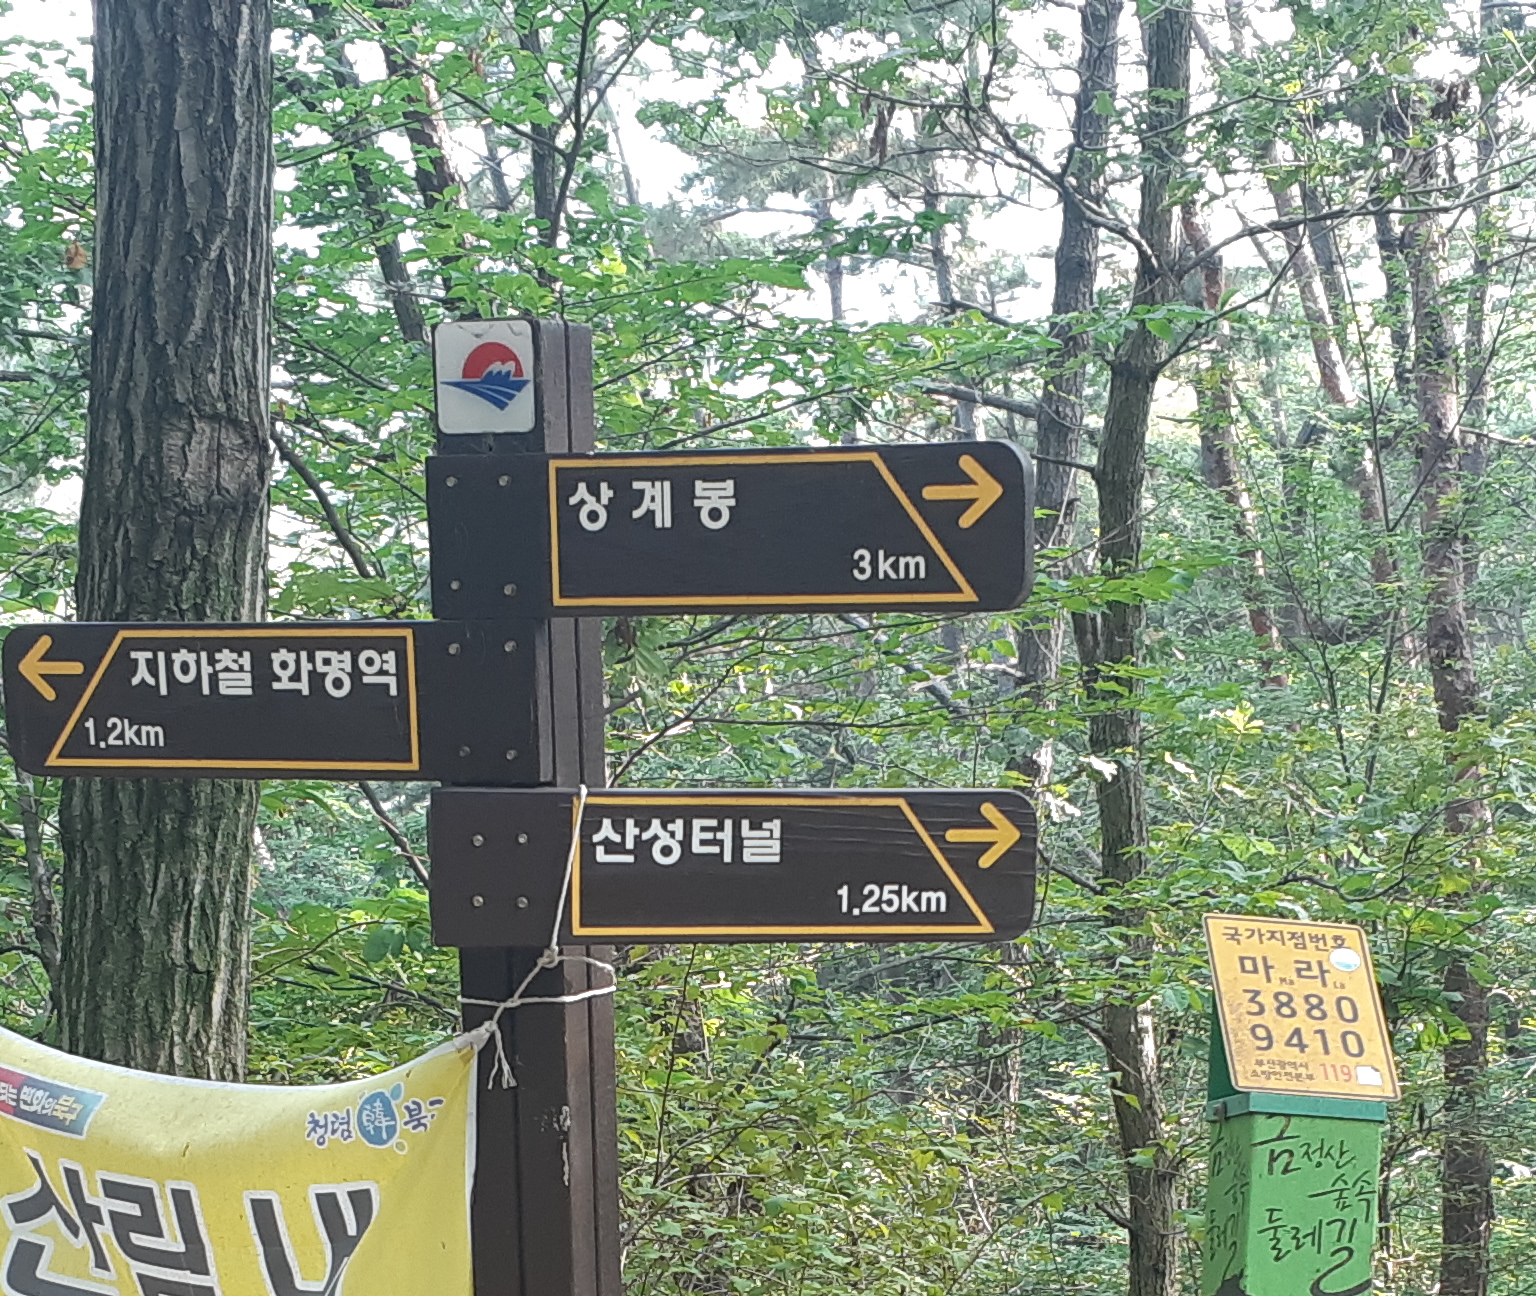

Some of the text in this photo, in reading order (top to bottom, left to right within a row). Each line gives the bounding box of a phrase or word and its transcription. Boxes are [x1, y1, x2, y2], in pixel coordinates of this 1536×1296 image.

[568, 475, 737, 535] 상계봉
[128, 645, 399, 698] 지하철 화명역
[83, 715, 165, 751] 1.2km
[590, 814, 783, 868] 산성터널
[835, 883, 947, 917] 1.25km
[1221, 926, 1351, 952] 국가지점번호
[1238, 955, 1331, 988] 마 라
[1242, 988, 1360, 1024] 3880
[1249, 1023, 1365, 1059] 9410
[1320, 1063, 1353, 1082] 119
[52, 1094, 85, 1126] 북구
[1307, 1170, 1377, 1223] 숲속
